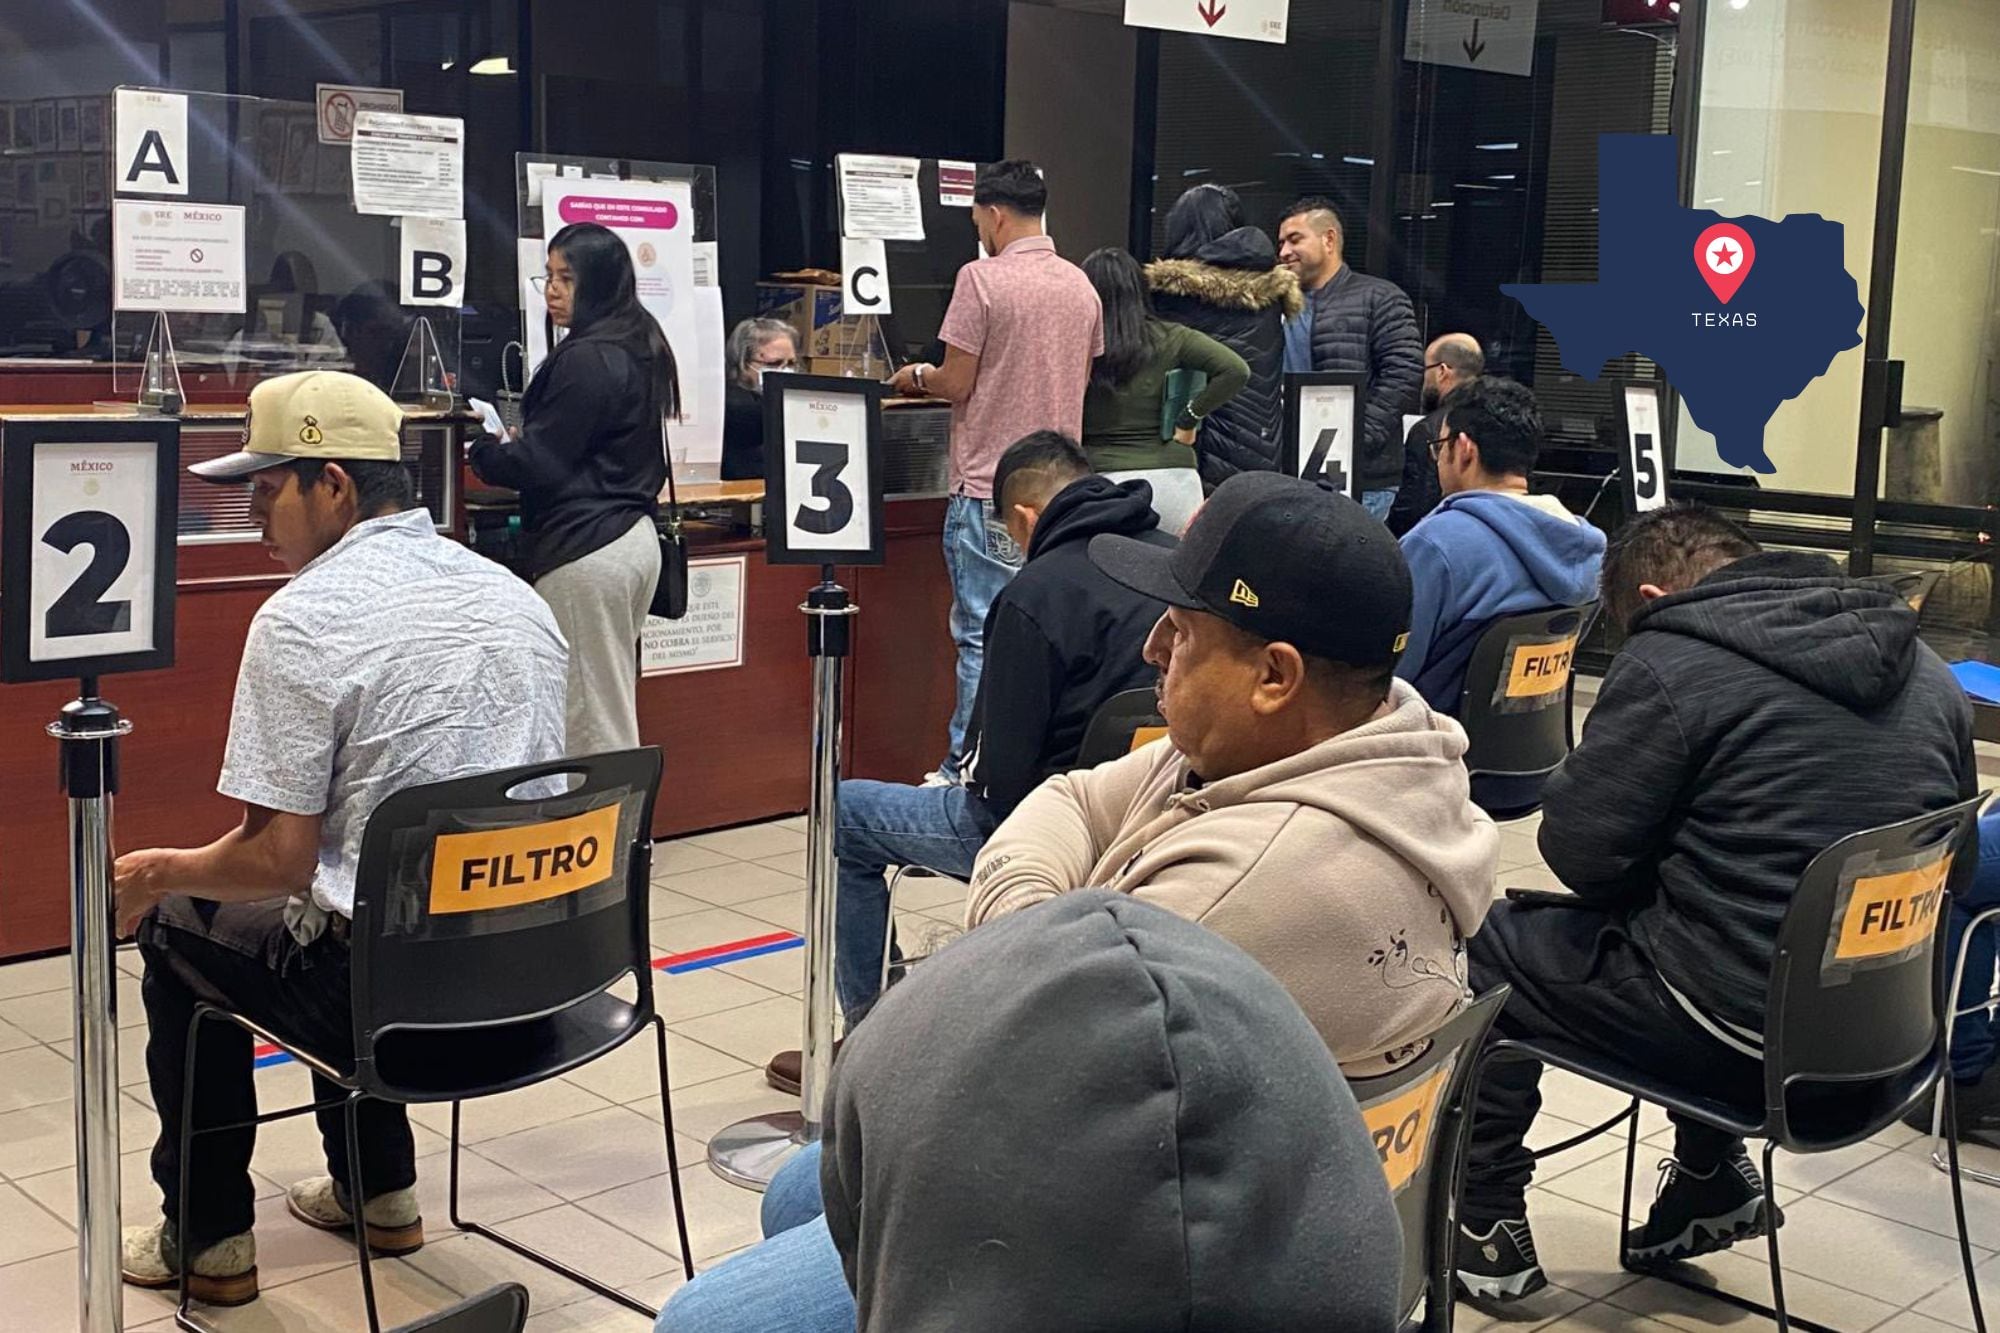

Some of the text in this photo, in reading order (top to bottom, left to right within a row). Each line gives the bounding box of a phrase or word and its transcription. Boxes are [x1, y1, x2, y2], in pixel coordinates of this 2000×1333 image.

[126, 130, 180, 184] A
[184, 210, 222, 221] MÉXICO
[413, 250, 453, 298] B
[851, 266, 881, 306] C
[809, 402, 839, 412] MÉXICO
[70, 460, 113, 471] MÉXICO
[1300, 428, 1347, 491] 4
[1634, 433, 1657, 499] 5
[793, 440, 853, 534] 3
[41, 510, 131, 638] 2
[644, 639, 659, 650] NO
[660, 637, 690, 649] COBRA
[460, 835, 599, 892] FILTRO
